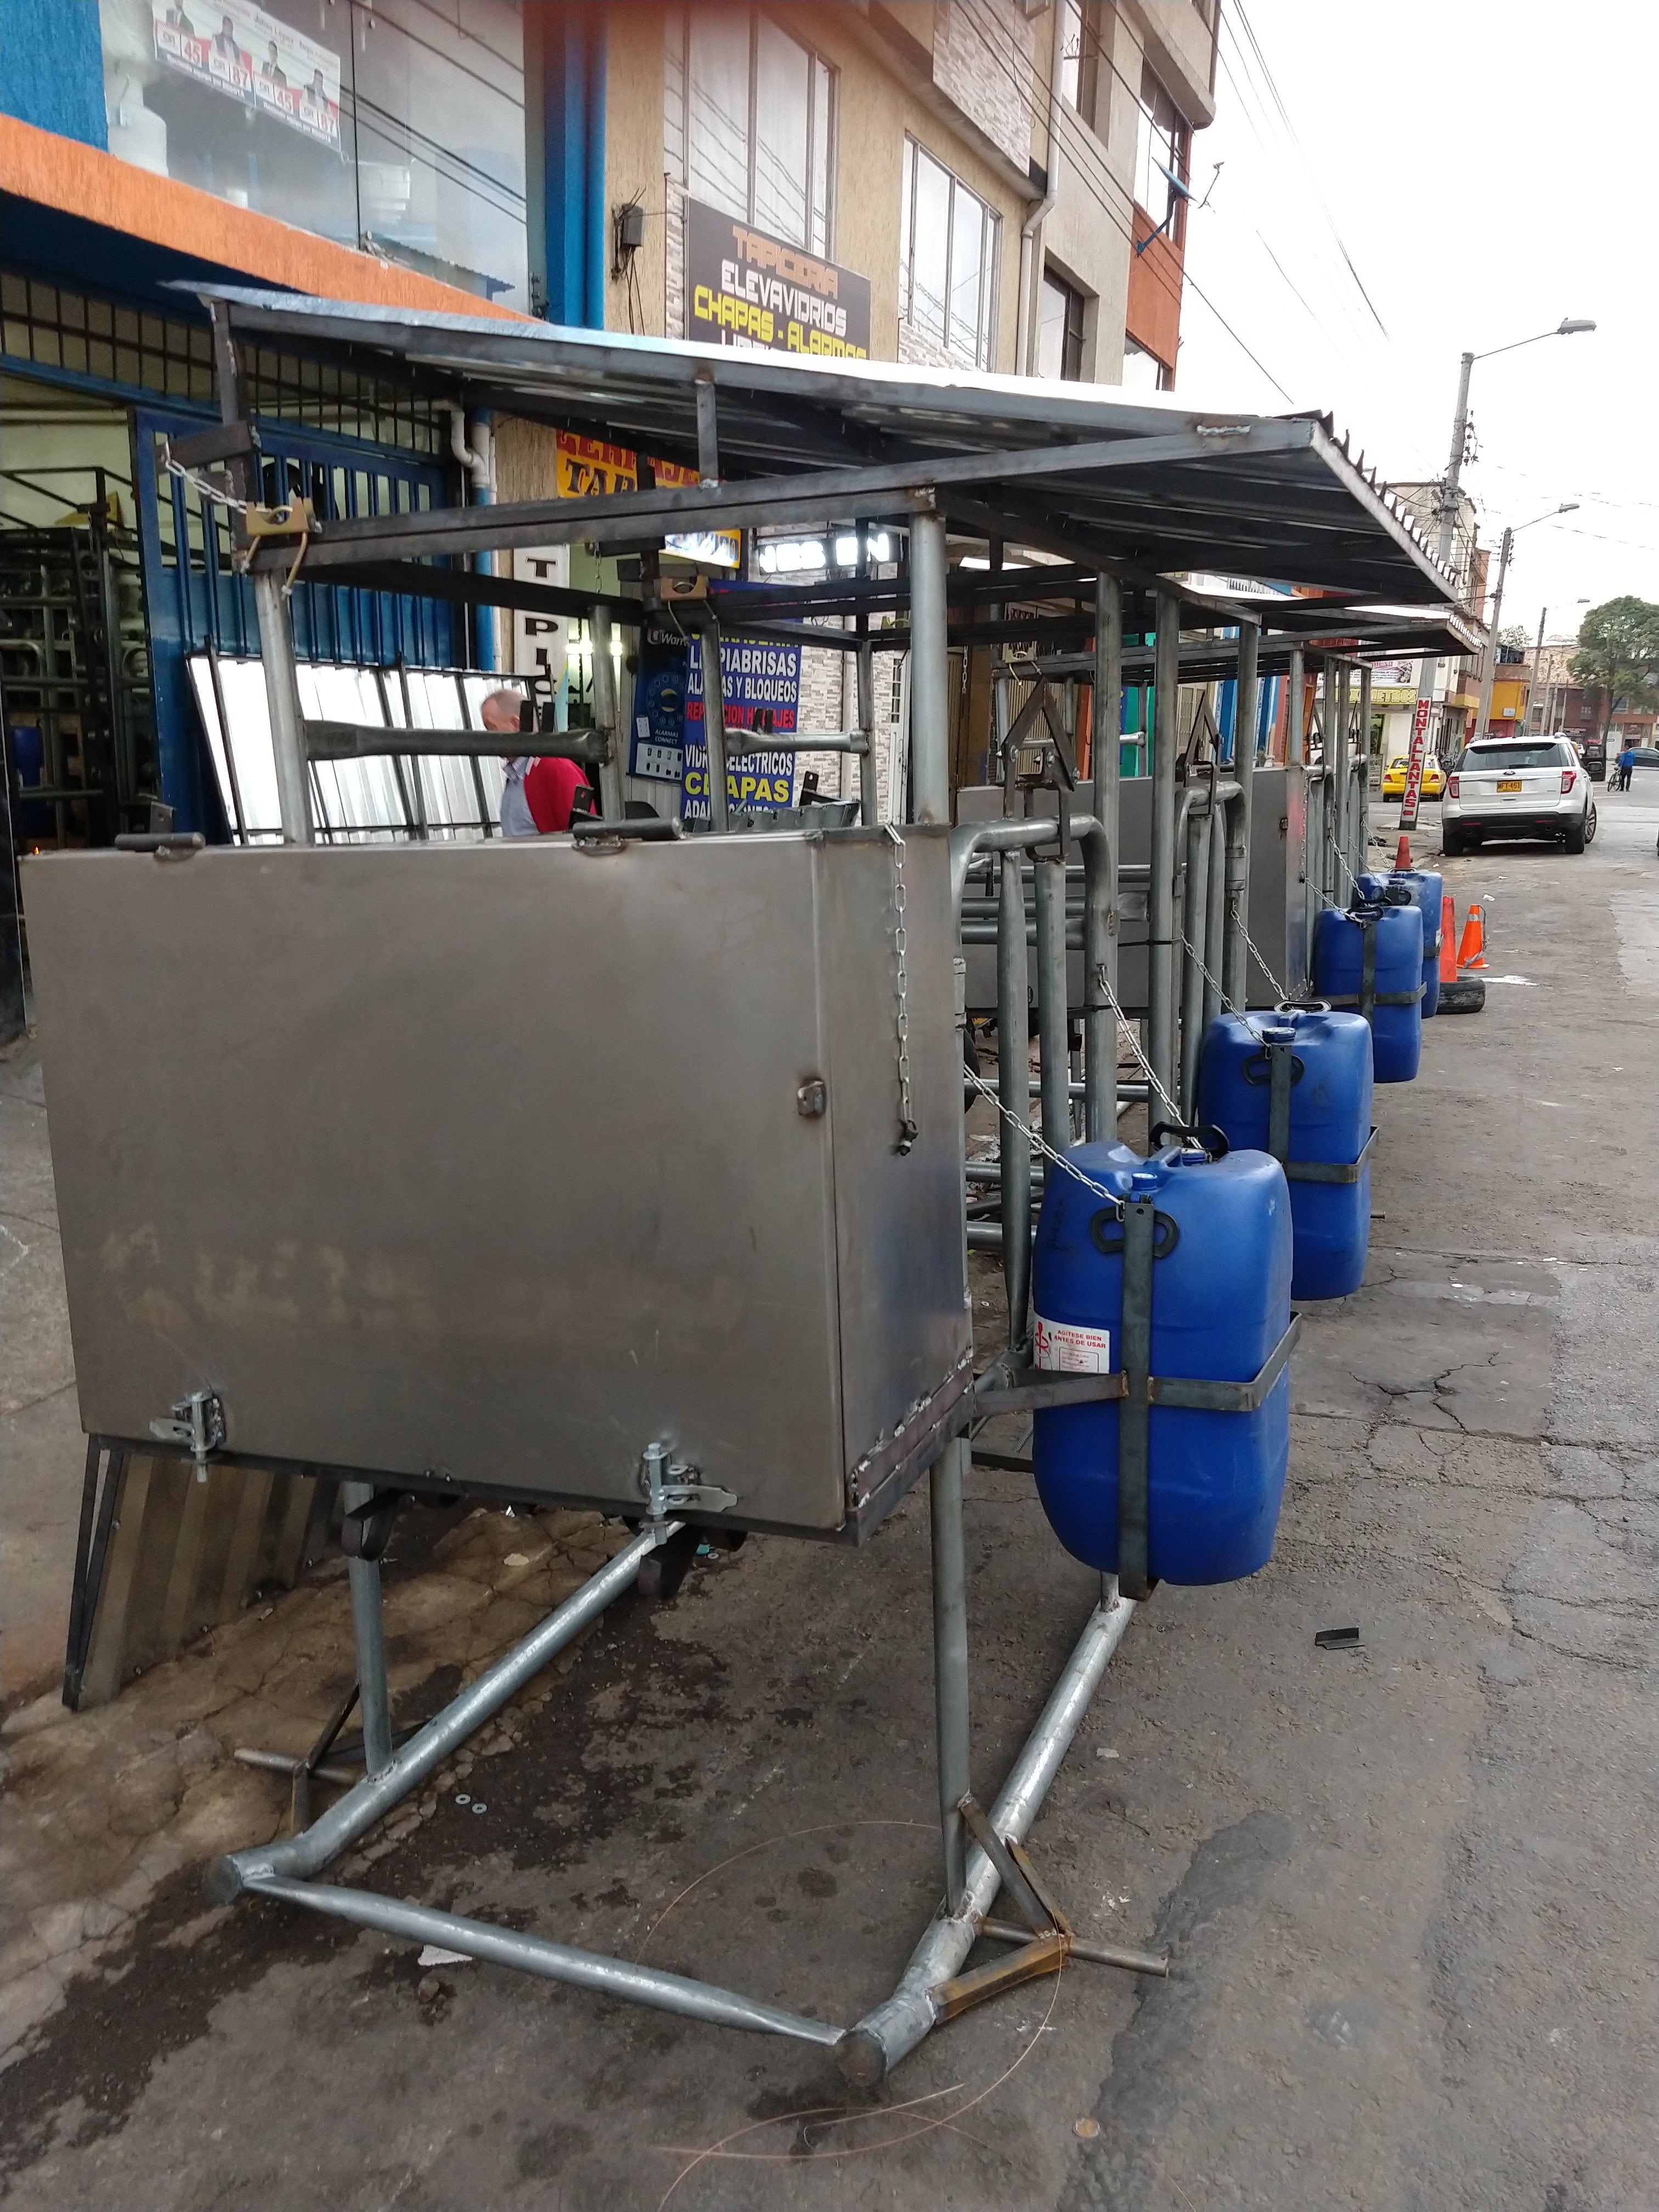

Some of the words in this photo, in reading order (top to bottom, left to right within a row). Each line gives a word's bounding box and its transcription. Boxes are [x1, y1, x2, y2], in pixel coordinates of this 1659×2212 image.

[184, 40, 201, 63] 45
[733, 225, 838, 300] TAPICERIA
[722, 259, 847, 337] ELEVAVIDRIOS
[695, 285, 774, 343] CHAPAS
[690, 645, 797, 678] LPIABRISAS
[687, 673, 733, 698] ALAS
[736, 675, 743, 698] Y
[744, 677, 797, 703] BLOQUEOS
[687, 701, 744, 725] REPCIÓN
[747, 706, 795, 729] HAJES
[654, 729, 679, 738] ALARMAS
[654, 736, 678, 744] CONNECT
[1404, 700, 1430, 808] MONTALLANTAS
[1054, 1335, 1074, 1344] ANTES
